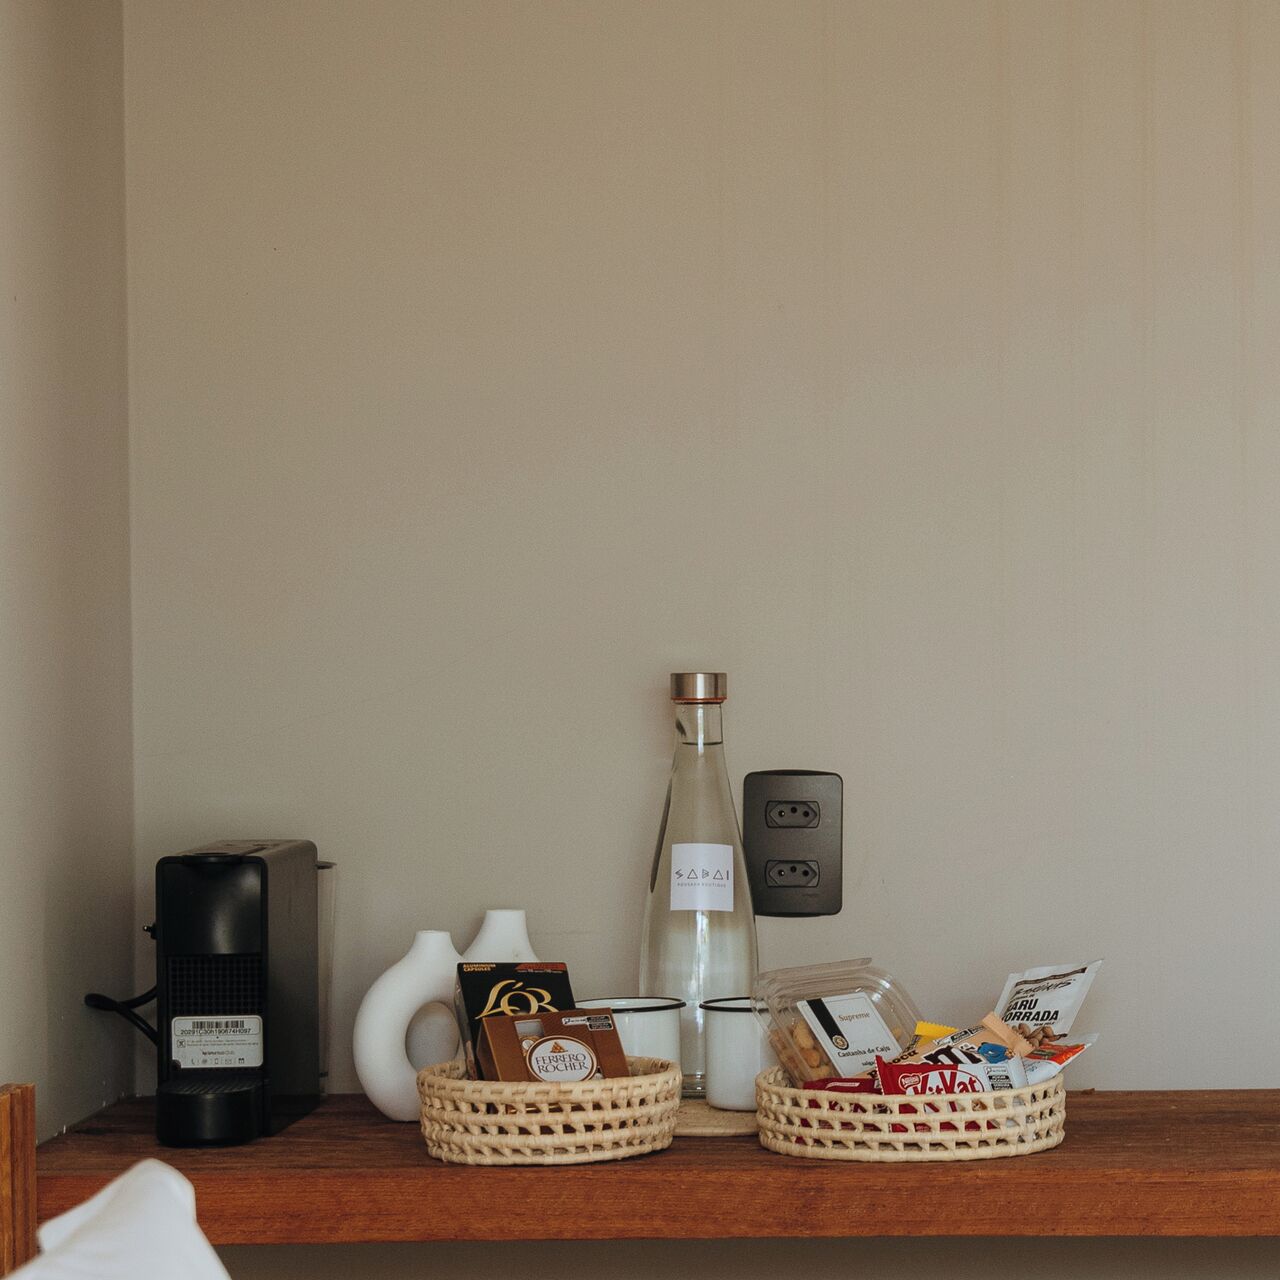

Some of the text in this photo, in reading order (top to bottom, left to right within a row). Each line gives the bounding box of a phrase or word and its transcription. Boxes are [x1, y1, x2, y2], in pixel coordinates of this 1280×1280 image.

[838, 1011, 871, 1023] Supreme
[1003, 1010, 1060, 1022] ORRADA
[837, 1048, 867, 1058] Castanha
[875, 1045, 891, 1053] Caju
[535, 1053, 587, 1065] FERRERO
[538, 1061, 589, 1074] ROCHER
